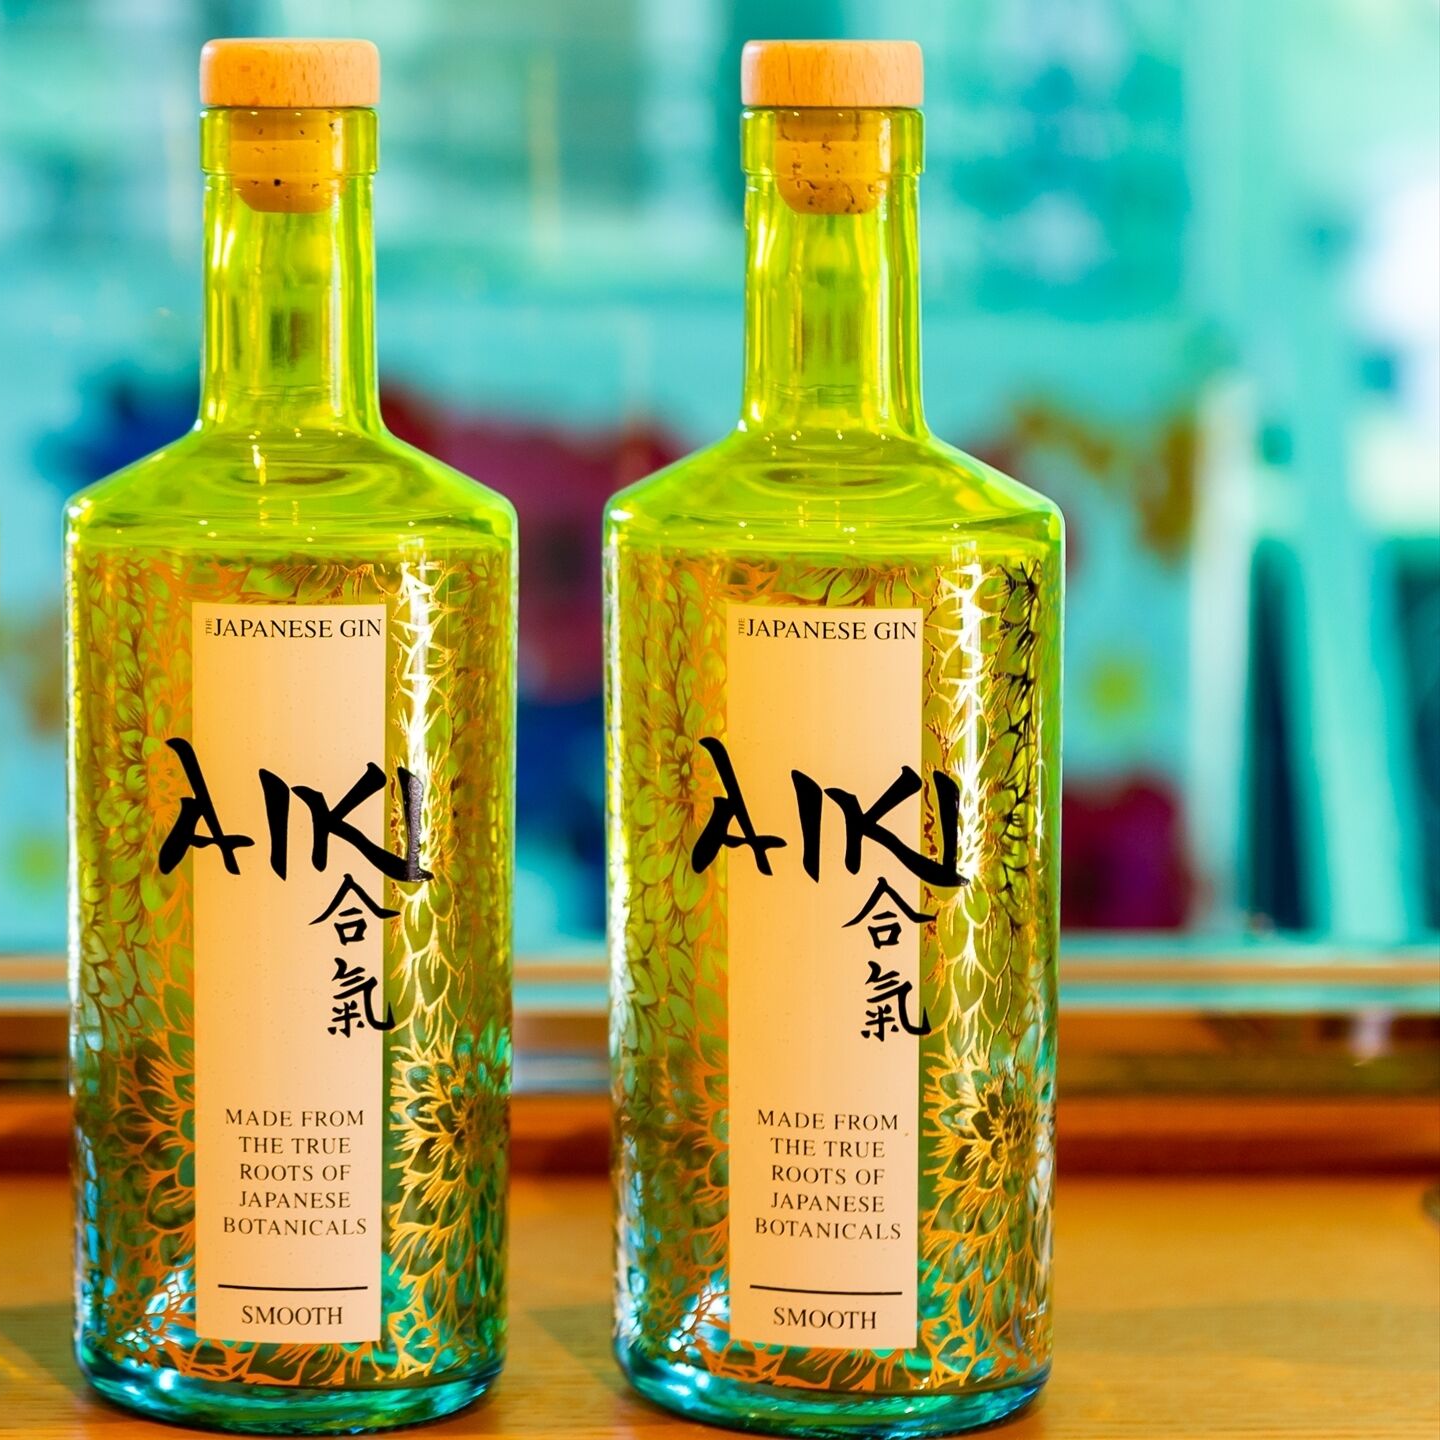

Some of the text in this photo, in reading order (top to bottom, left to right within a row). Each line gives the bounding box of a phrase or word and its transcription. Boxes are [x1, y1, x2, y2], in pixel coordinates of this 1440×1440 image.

[214, 619, 332, 638] JAPANESE
[340, 619, 382, 637] GIN
[747, 619, 866, 640] JAPANESE
[874, 622, 917, 640] GIN
[159, 738, 434, 882] AIKI
[691, 737, 970, 887] AIKI
[226, 1109, 364, 1127] MADE FROM
[758, 1110, 898, 1131] MADE FROM
[239, 1137, 351, 1154] THE TRUE
[770, 1138, 885, 1158] THE TRUE
[240, 1164, 351, 1181] ROOTS OF
[772, 1165, 885, 1185] ROOTS OF
[239, 1191, 351, 1208] JAPANESE
[771, 1192, 884, 1212] JAPANESE
[224, 1217, 366, 1235] BOTANICALS
[755, 1218, 901, 1240] BOTANICALS
[242, 1306, 343, 1325] SMOOTH
[773, 1307, 877, 1329] SMOOTH
